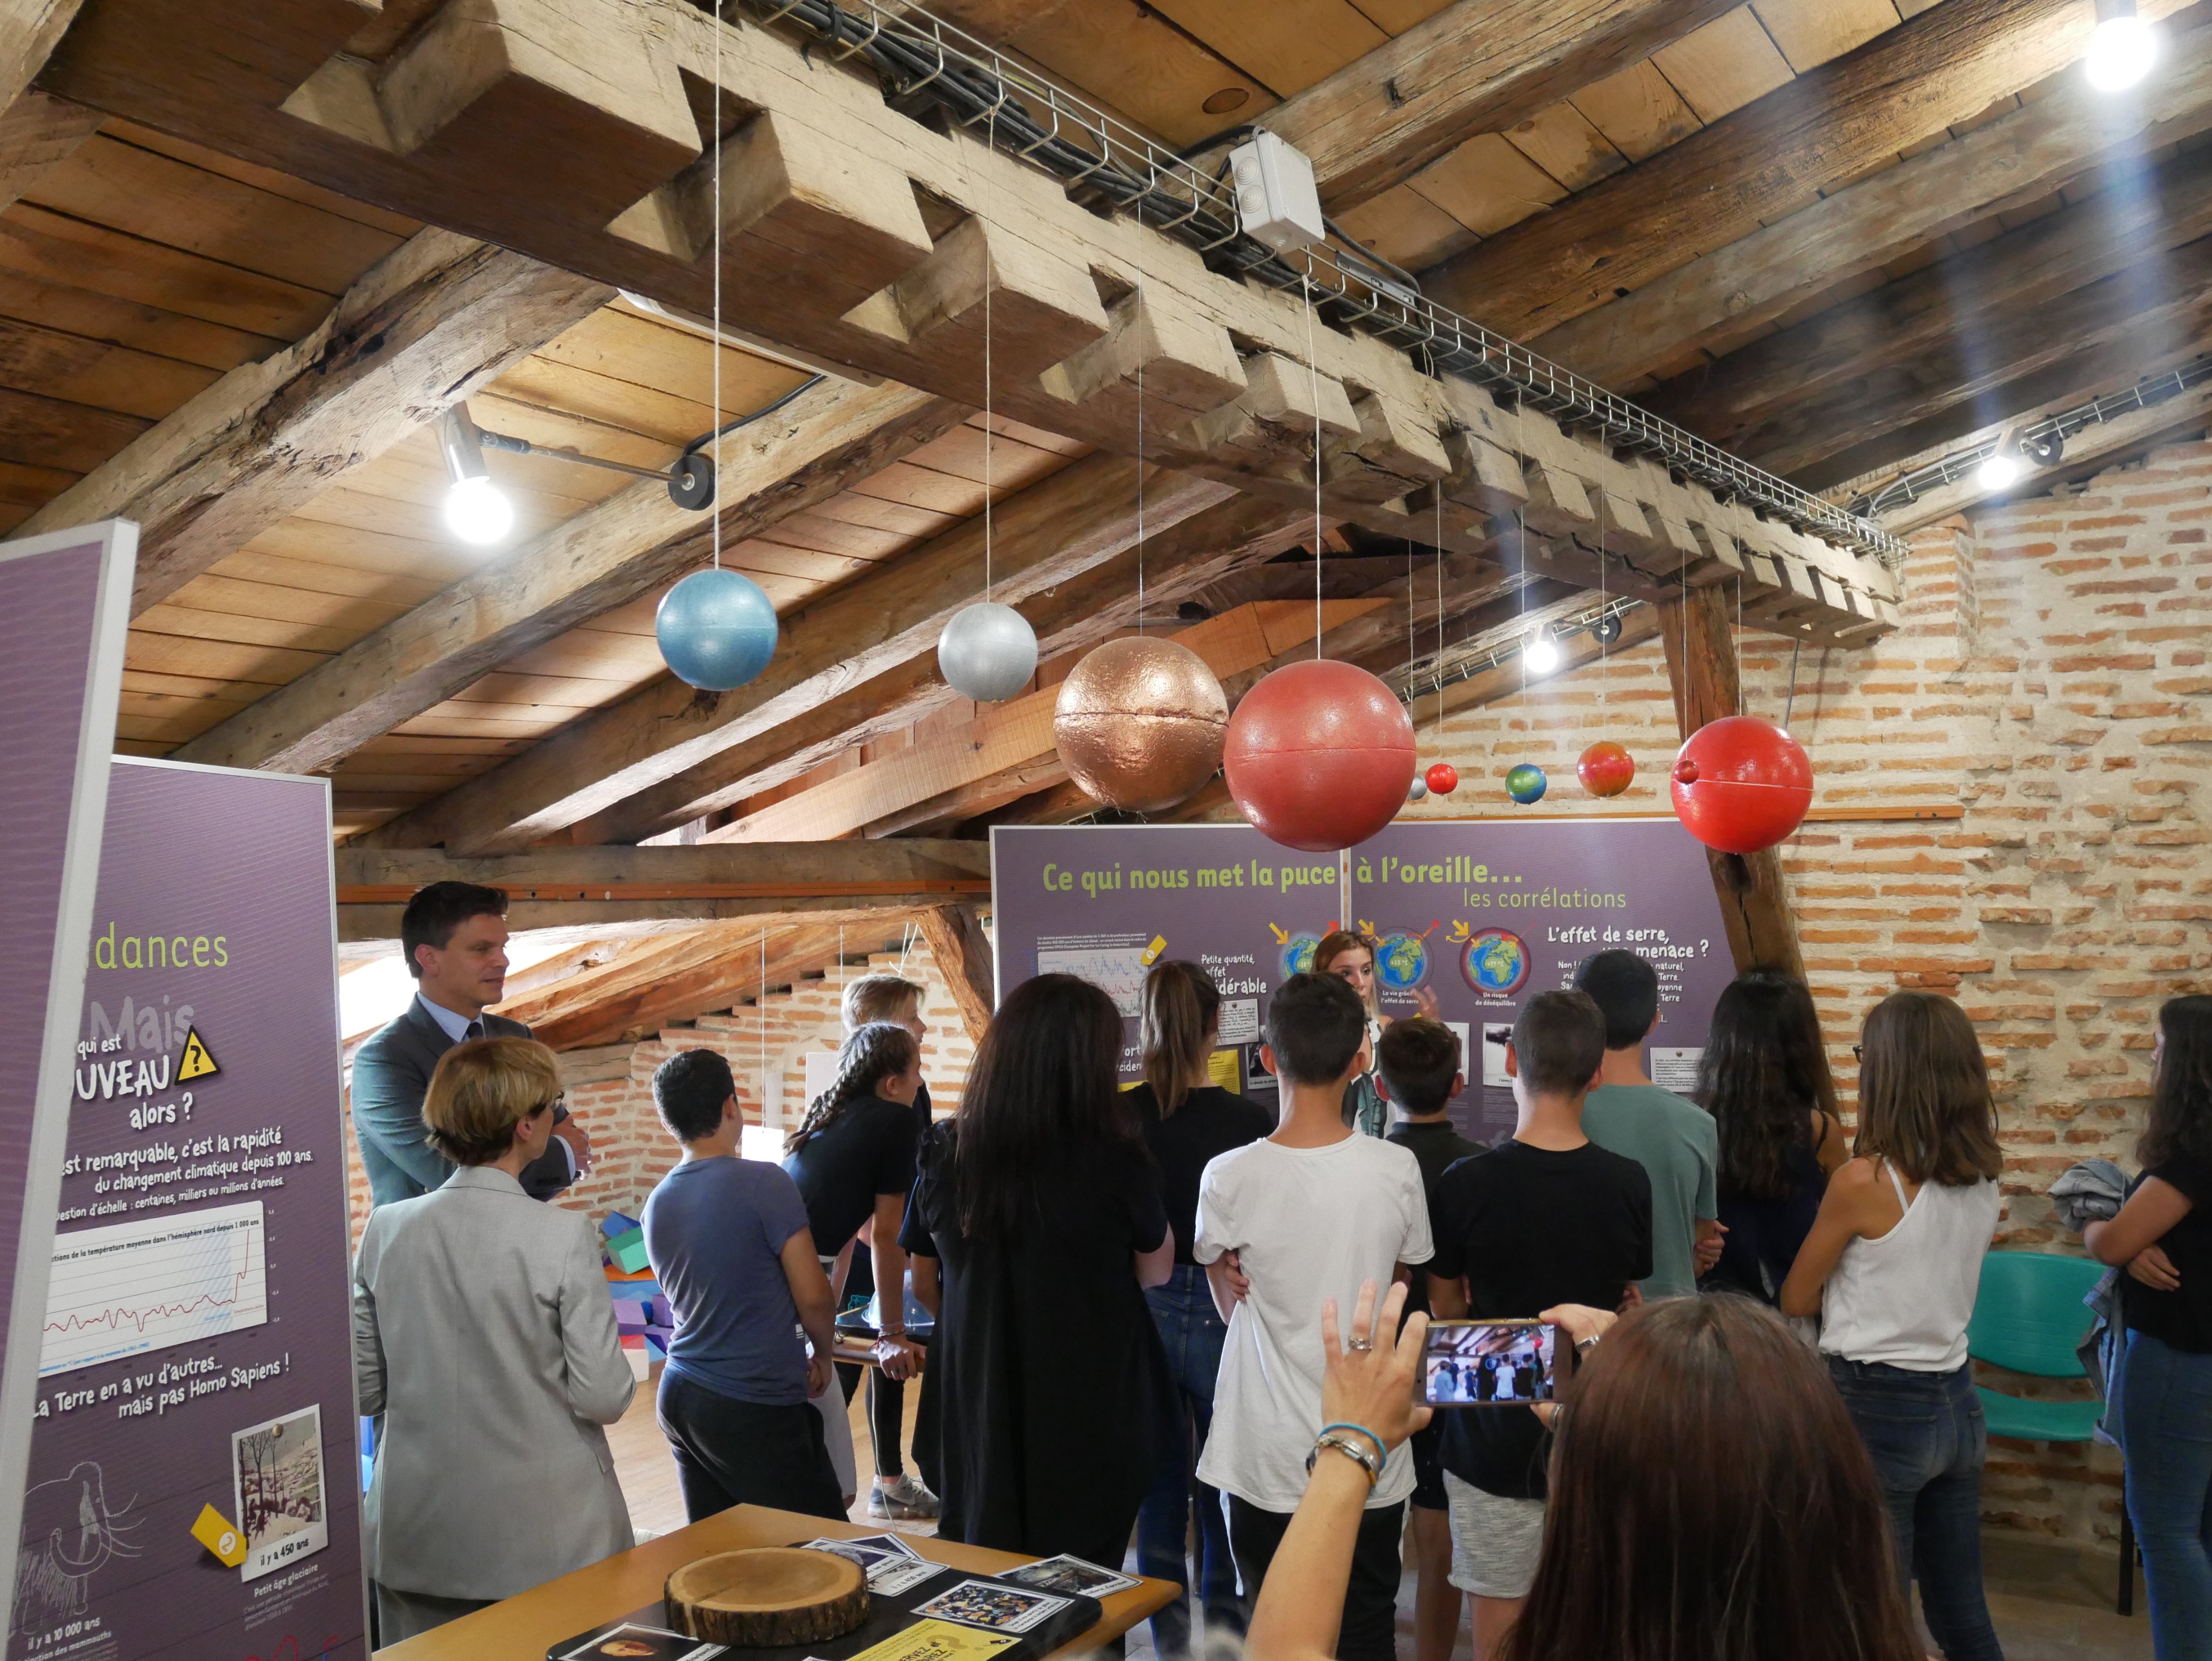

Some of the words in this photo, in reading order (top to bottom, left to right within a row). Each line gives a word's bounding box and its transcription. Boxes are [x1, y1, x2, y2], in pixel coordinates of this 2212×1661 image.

[1043, 863, 1073, 891] Ce
[1081, 862, 1121, 899] qui
[1130, 869, 1189, 889] nous
[1197, 863, 1244, 887] met
[1251, 859, 1274, 886] la
[1280, 866, 1336, 894] puce
[1357, 856, 1373, 883] à
[1464, 887, 1491, 908] les
[1498, 887, 1627, 908] corrélations
[87, 921, 228, 969] dances
[1603, 925, 1621, 943] de
[1625, 929, 1670, 945] serre,
[1635, 945, 1694, 958] menace
[1700, 938, 1709, 957] ?
[1201, 954, 1222, 964] Petite
[1224, 954, 1255, 967] quantité,
[1558, 961, 1572, 969] Non
[1574, 961, 1577, 969] !
[1655, 962, 1684, 972] naturel,
[1483, 1000, 1516, 1008] déséquilibre
[1661, 994, 1680, 1002] Terre
[90, 995, 194, 1054] Mais
[77, 1036, 97, 1061] qui
[101, 1034, 122, 1052] est
[130, 1102, 176, 1130] alors
[183, 1091, 193, 1120] ?
[86, 1142, 178, 1172] remarquable,
[218, 1134, 230, 1153] la
[234, 1126, 282, 1154] rapidité
[95, 1176, 110, 1194] du
[113, 1166, 182, 1192] changement
[185, 1160, 239, 1179] climatique
[241, 1154, 274, 1174] depuis
[276, 1150, 292, 1166] 100
[294, 1150, 314, 1164] ans.
[135, 1193, 177, 1209] centaines,
[178, 1189, 207, 1201] milliers
[208, 1187, 219, 1196] ou
[221, 1182, 248, 1194] millions
[71, 1251, 79, 1259] de
[87, 1245, 125, 1256] température
[126, 1238, 151, 1250] moyenne
[203, 1226, 215, 1234] nord
[217, 1224, 234, 1232] depuis
[239, 1219, 249, 1227] 000
[55, 1389, 95, 1412] Terre
[100, 1382, 118, 1401] en
[122, 1378, 133, 1394] a
[136, 1373, 153, 1389] vu
[118, 1395, 153, 1418] mais
[159, 1387, 185, 1415] pas
[190, 1376, 227, 1398] Homo
[231, 1360, 280, 1389] Sapiens
[285, 1352, 289, 1372] !
[260, 1554, 265, 1567] il
[267, 1555, 271, 1565] y
[274, 1551, 279, 1560] a
[280, 1543, 294, 1557] 450
[296, 1538, 309, 1550] ans
[254, 1583, 272, 1598] Petit
[273, 1578, 287, 1591] âge
[288, 1564, 319, 1586] glaciaire
[28, 1637, 33, 1650] il
[36, 1637, 42, 1650] y
[44, 1633, 52, 1644] a
[53, 1627, 63, 1641] 10
[65, 1621, 82, 1637] 000
[84, 1617, 101, 1631] ans
[55, 1646, 68, 1656] des
[68, 1630, 112, 1652] mammouths
